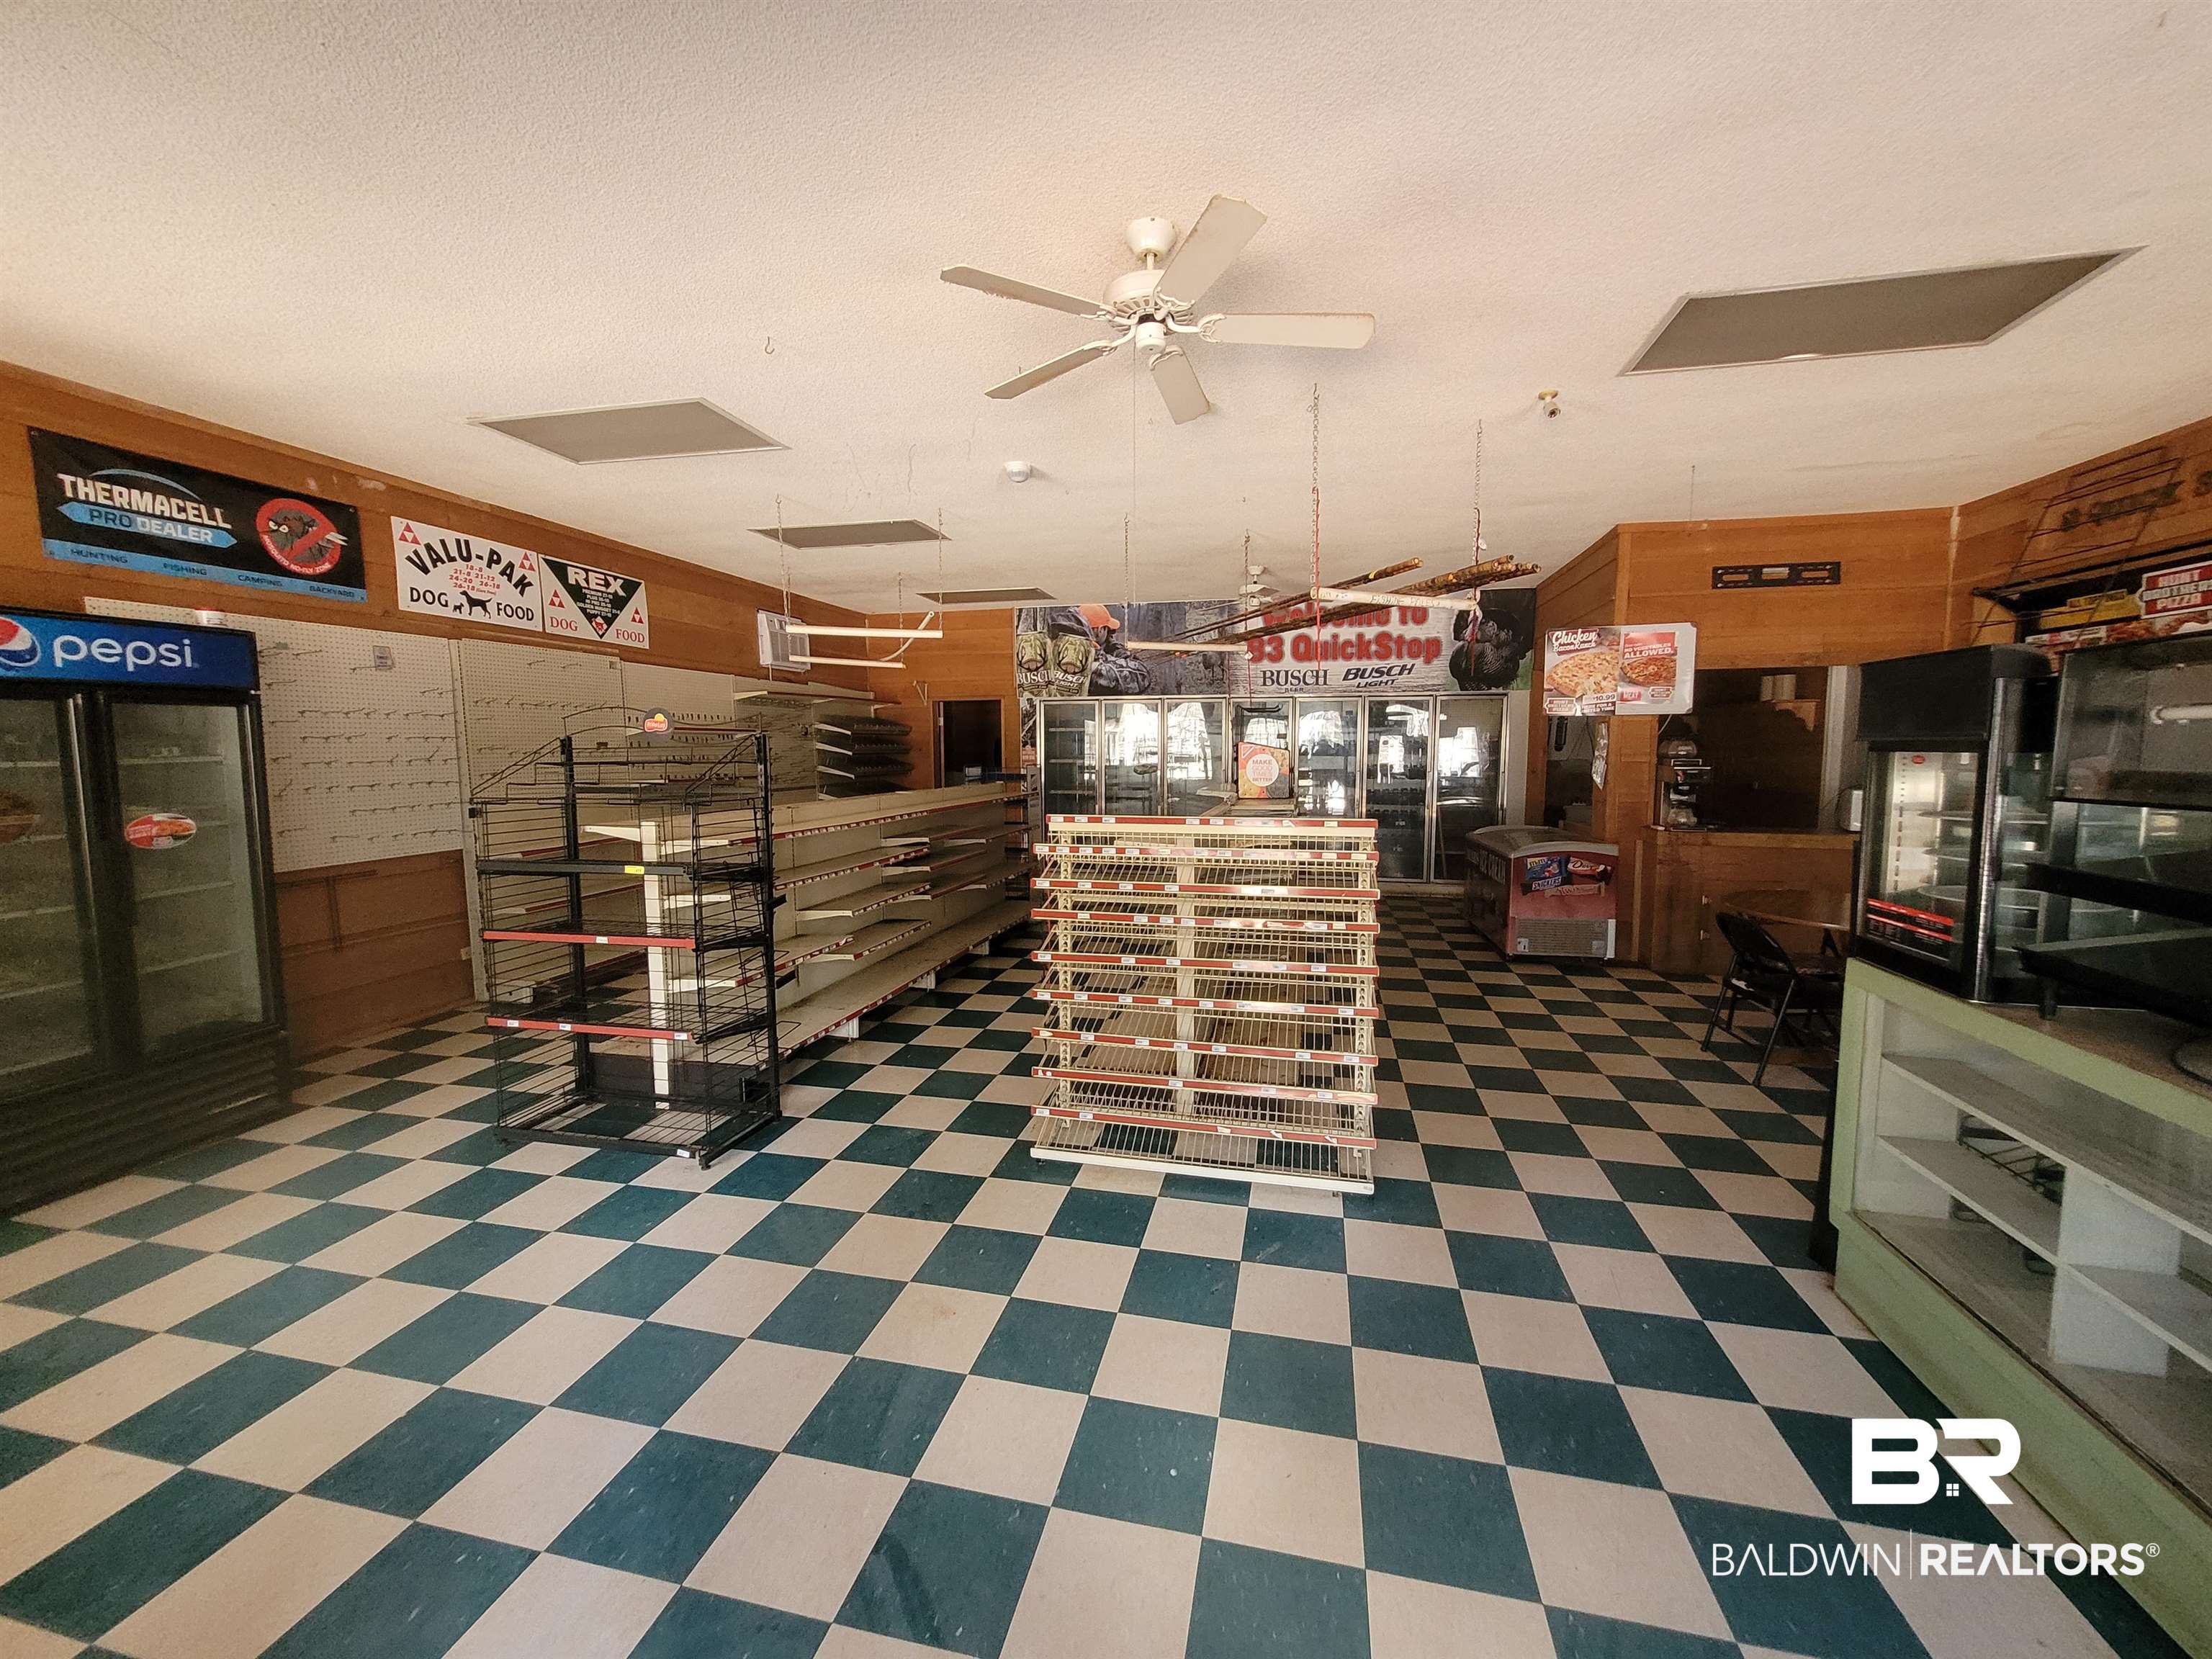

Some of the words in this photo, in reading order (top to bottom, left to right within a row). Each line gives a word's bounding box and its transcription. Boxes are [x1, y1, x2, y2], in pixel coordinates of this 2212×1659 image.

[57, 473, 232, 529] THERMACELL
[89, 508, 132, 528] PRO
[136, 516, 214, 543] DEALER
[70, 548, 128, 564] HUNTING
[163, 562, 207, 576] FISHING
[238, 574, 283, 588] CAMPING
[309, 585, 355, 598] BACKYARD
[405, 538, 534, 597] VALU-PAK
[475, 572, 495, 582] 21-12
[567, 566, 626, 598] REX
[409, 586, 449, 608] DOG
[496, 602, 534, 621] FOOD
[549, 616, 578, 631] DOG
[616, 629, 645, 643] FOOD
[1552, 629, 1598, 645] Chicken
[53, 635, 192, 671] pepsi
[1290, 631, 1442, 664] QuickStop
[1262, 669, 1330, 687] BUSCH
[1342, 663, 1416, 682] BUSCH
[1355, 679, 1398, 689] LIGHT
[1532, 876, 1561, 890] SNICKERS
